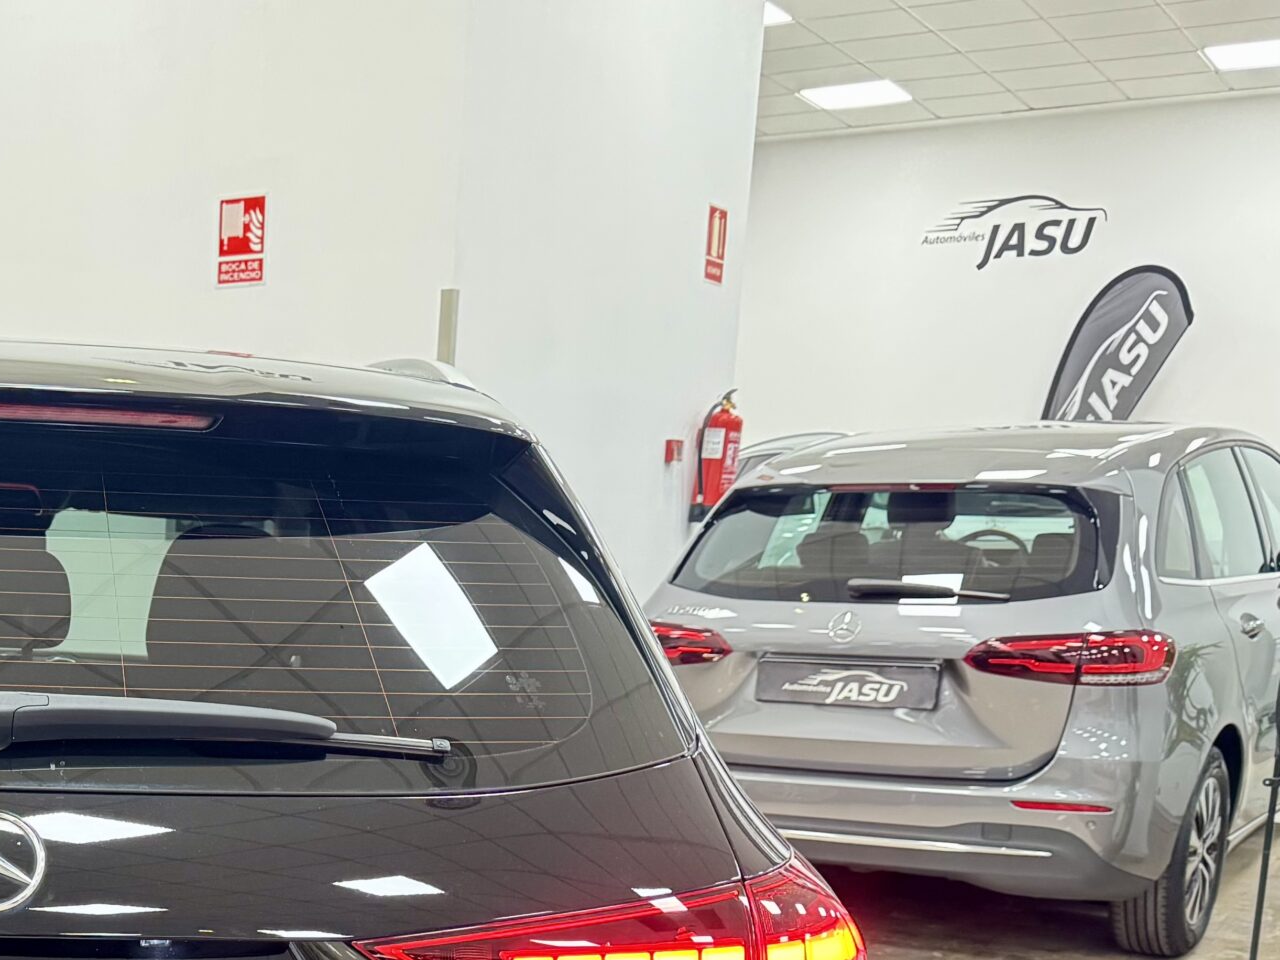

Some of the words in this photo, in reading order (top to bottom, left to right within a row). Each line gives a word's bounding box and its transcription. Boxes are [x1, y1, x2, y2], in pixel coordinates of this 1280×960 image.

[921, 232, 986, 246] Automóviles
[976, 217, 1097, 271] JASU
[825, 682, 902, 704] JASU
